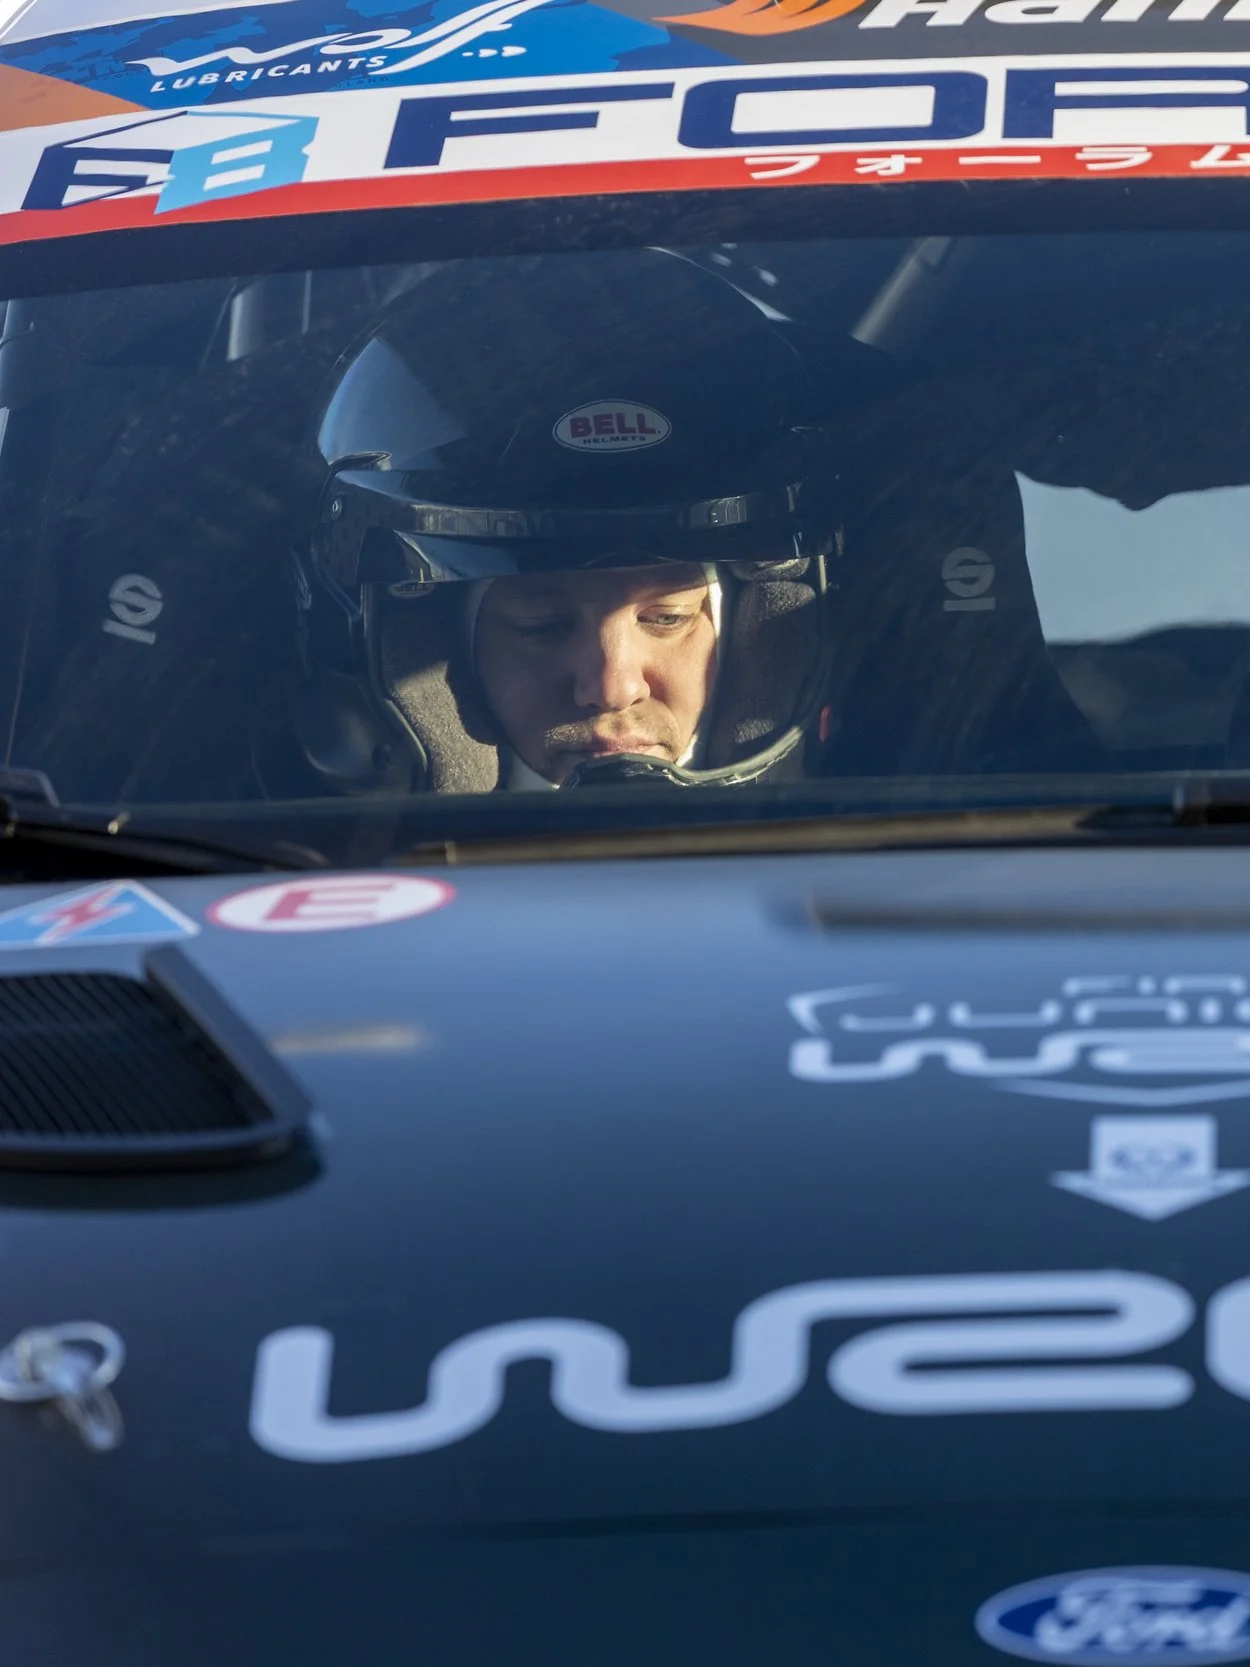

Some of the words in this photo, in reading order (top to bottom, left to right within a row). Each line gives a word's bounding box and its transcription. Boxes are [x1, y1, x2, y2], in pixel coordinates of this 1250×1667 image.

[150, 55, 388, 93] LUBRICANTS
[570, 412, 657, 438] BELL
[582, 435, 647, 444] HELMETS
[264, 882, 396, 921] E
